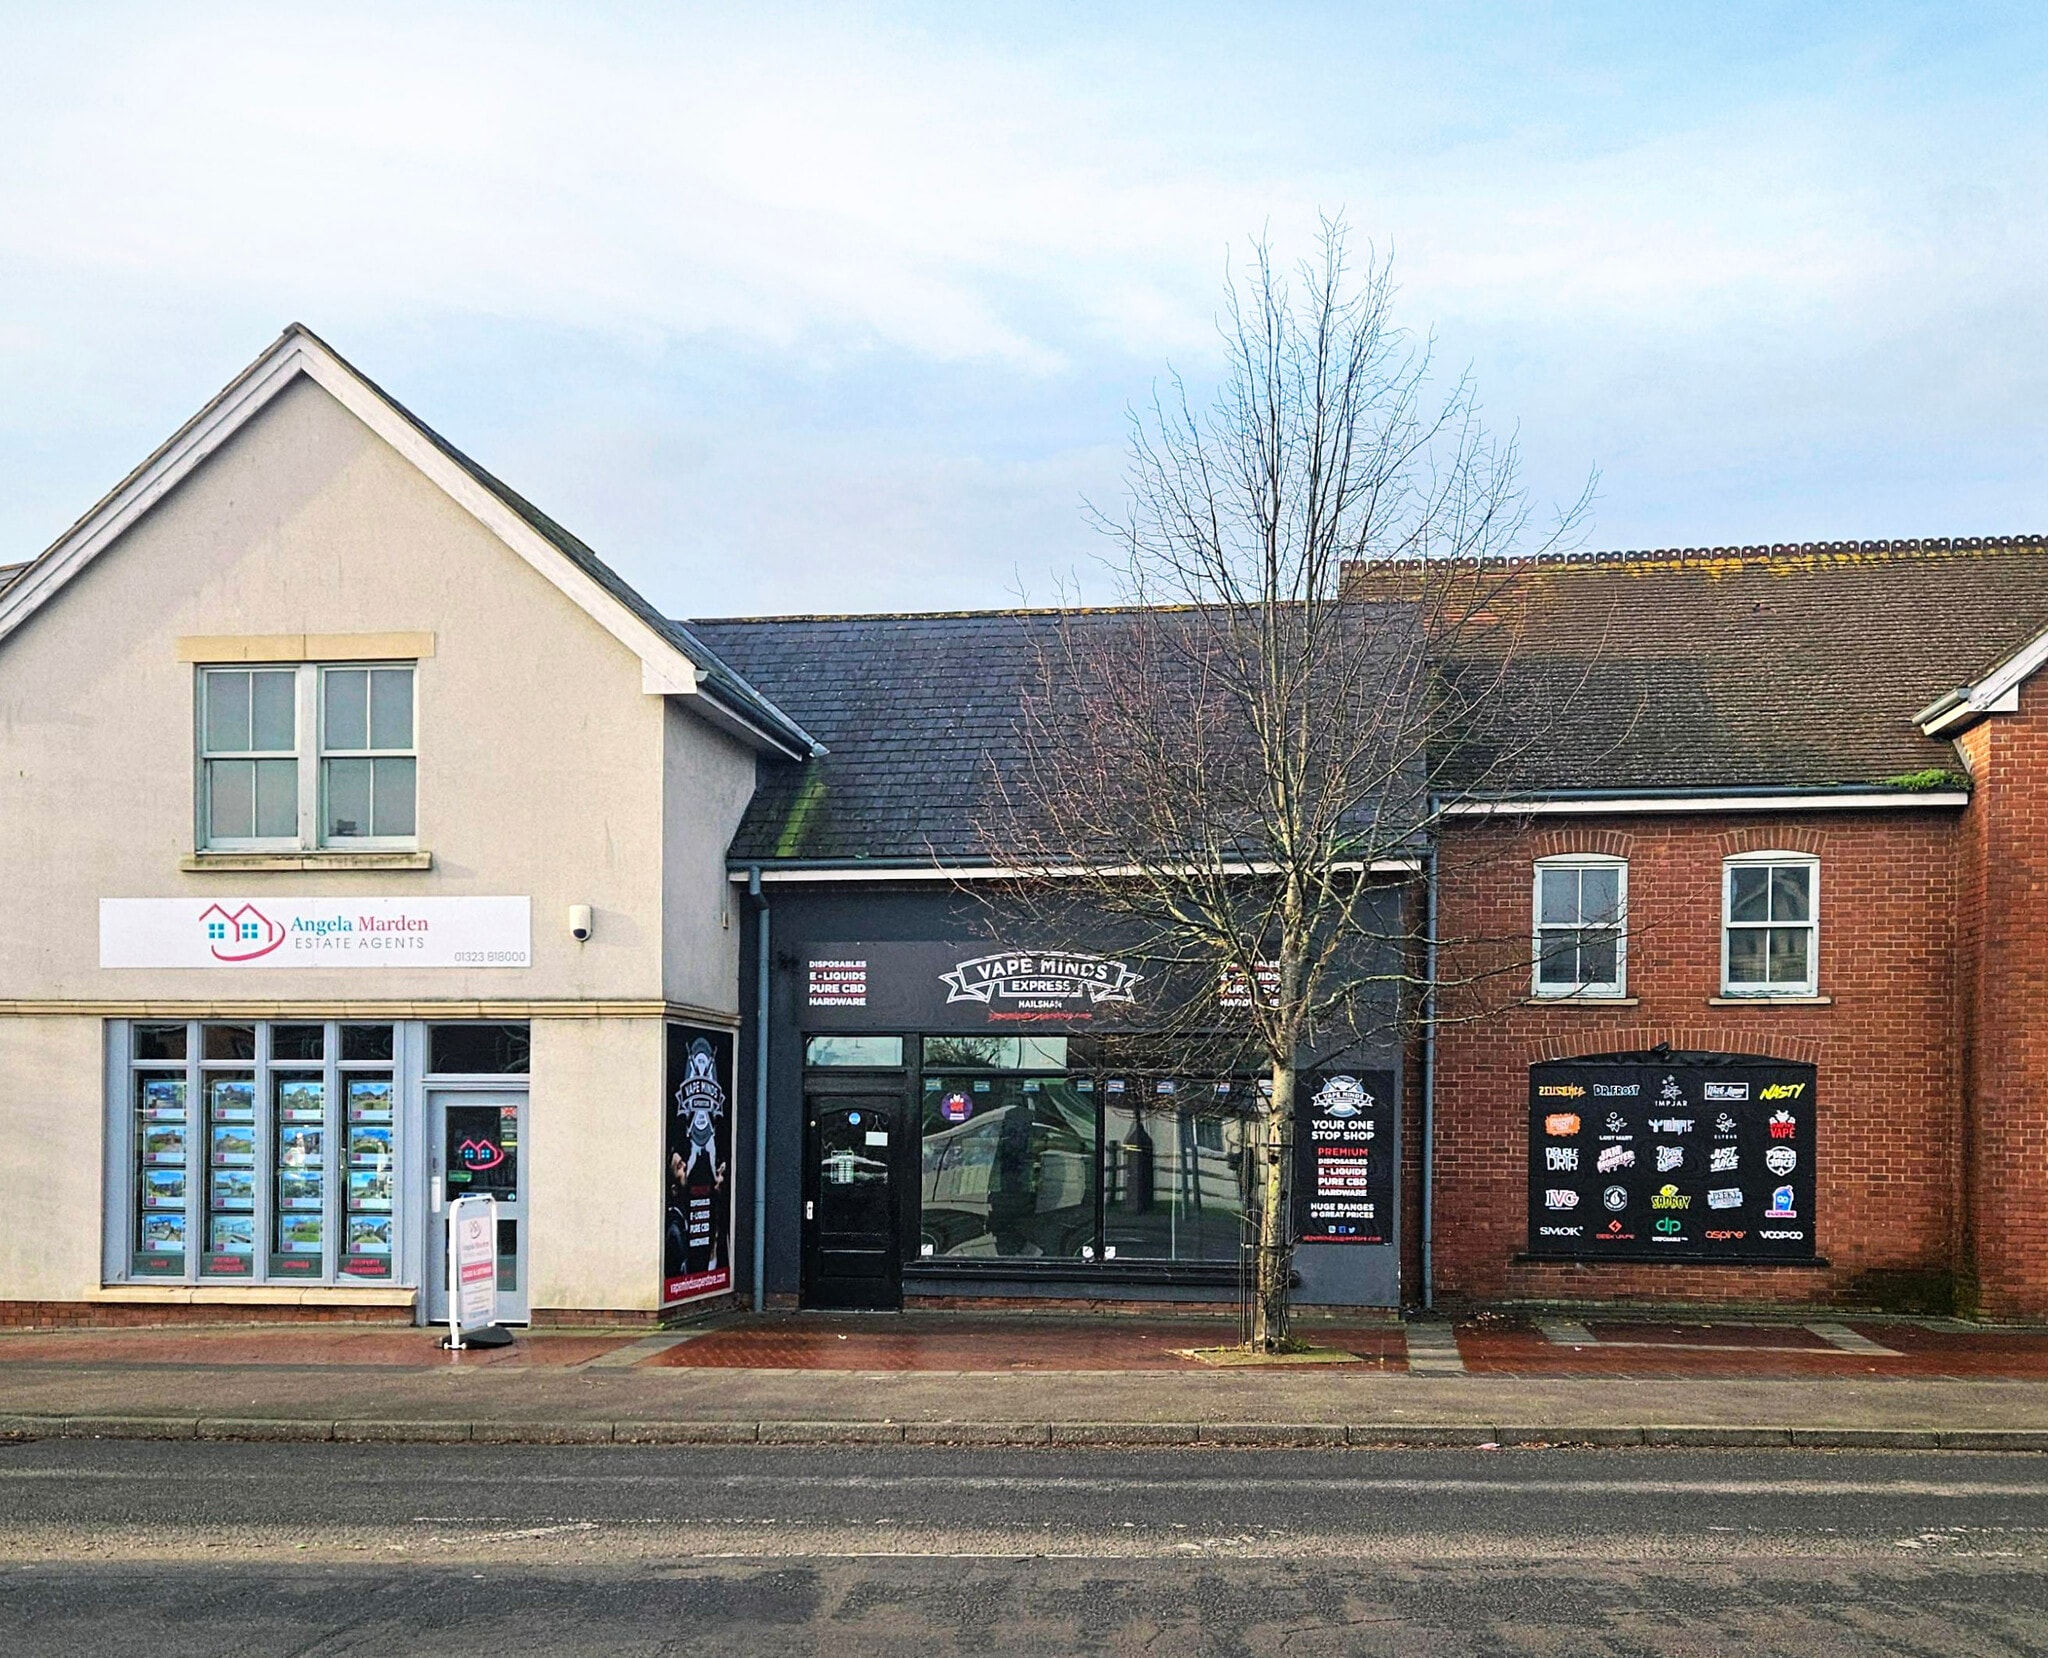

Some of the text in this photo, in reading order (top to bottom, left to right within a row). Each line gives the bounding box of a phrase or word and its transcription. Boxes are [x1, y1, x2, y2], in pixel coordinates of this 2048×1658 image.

[290, 915, 429, 936] Angela Marden
[295, 937, 425, 949] ESTATE AGENTS
[454, 951, 526, 962] 01323 818000
[809, 960, 867, 968] DISPOSABLES
[976, 958, 1108, 981] VAPE MINDS
[809, 983, 867, 993] PURE CBD
[1011, 980, 1072, 992] EXPRESS
[809, 997, 867, 1006] HARDWARE
[684, 1081, 718, 1099] VAPE MINDS
[1759, 1083, 1806, 1100] NASTY
[1311, 1120, 1375, 1130] YOUR ONE
[1311, 1131, 1375, 1141] STOP SHOP
[1770, 1128, 1796, 1139] VAPE
[1317, 1147, 1368, 1156] PREMIUM
[1545, 1147, 1580, 1159] DOUBLE
[1598, 1145, 1623, 1161] JAM
[1710, 1146, 1738, 1160] JUST
[1710, 1156, 1740, 1169] JUICE
[1318, 1177, 1368, 1186] PURE CBD
[1317, 1188, 1368, 1196] HARDWARE
[1545, 1189, 1580, 1207] IVG
[1337, 1203, 1375, 1211] RANGES
[1346, 1211, 1375, 1219] PRICES
[1705, 1230, 1744, 1241] aspire
[1759, 1230, 1804, 1241] VOOPOO
